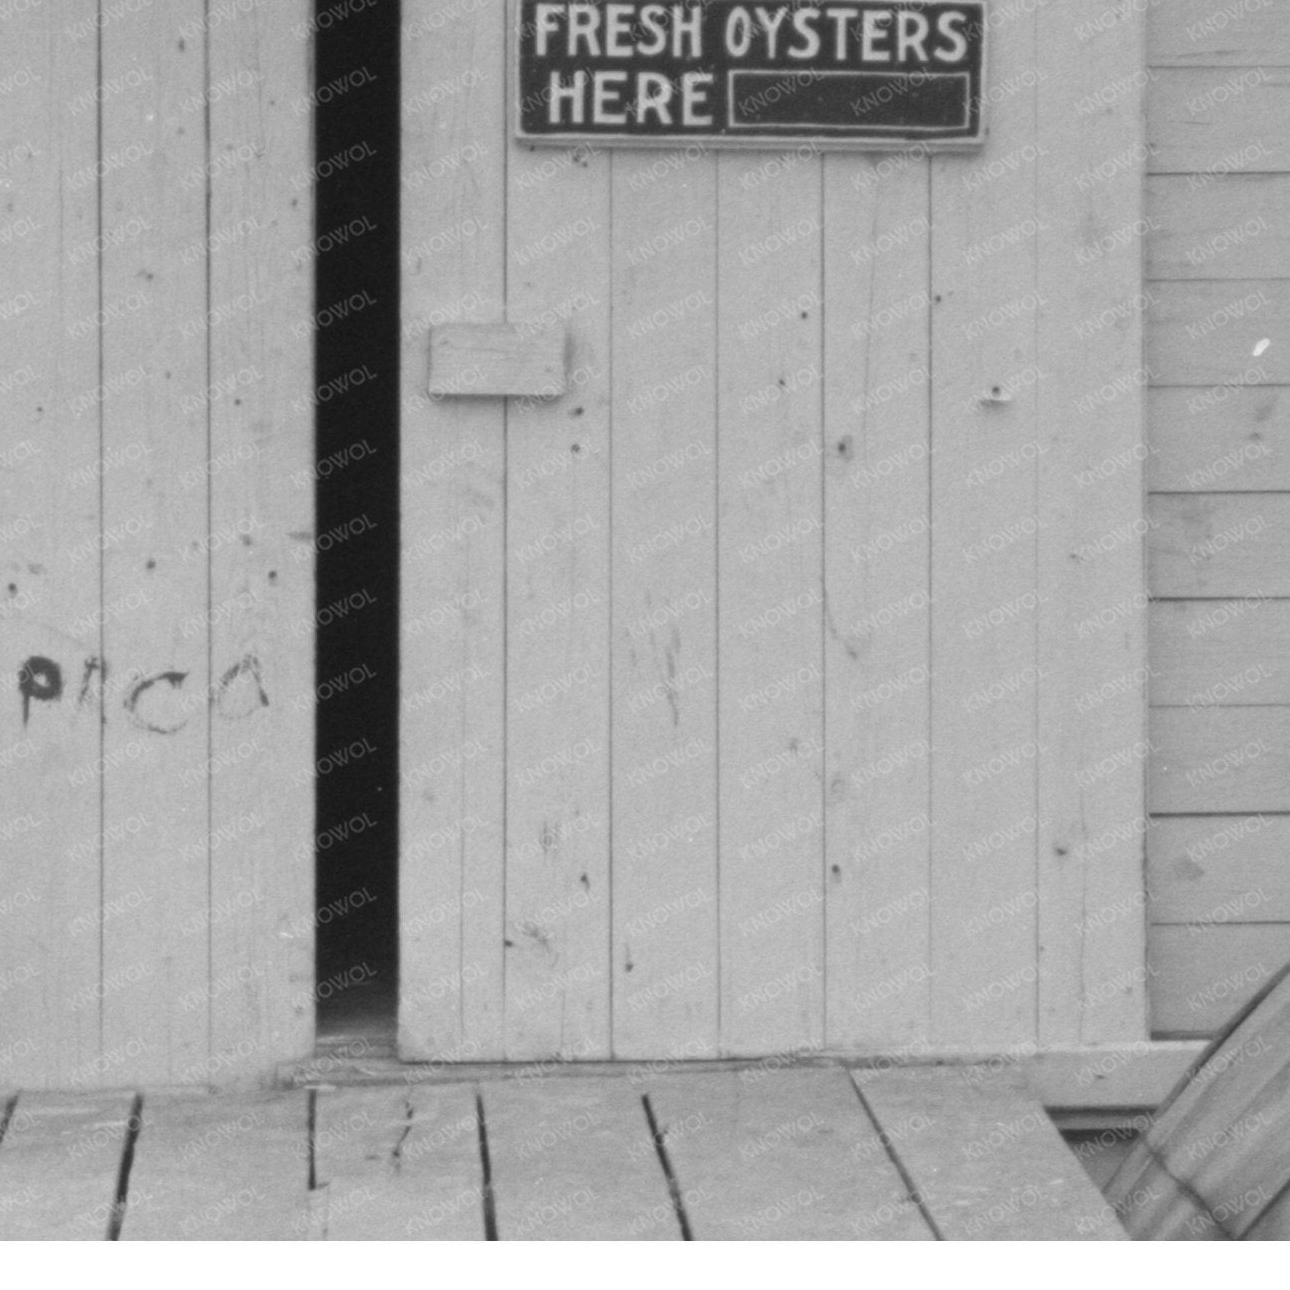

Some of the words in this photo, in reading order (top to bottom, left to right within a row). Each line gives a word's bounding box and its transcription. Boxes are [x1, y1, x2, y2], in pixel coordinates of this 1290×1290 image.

[534, 3, 703, 59] FRESH
[724, 6, 969, 64] OYSTERS
[548, 70, 714, 126] HERE
